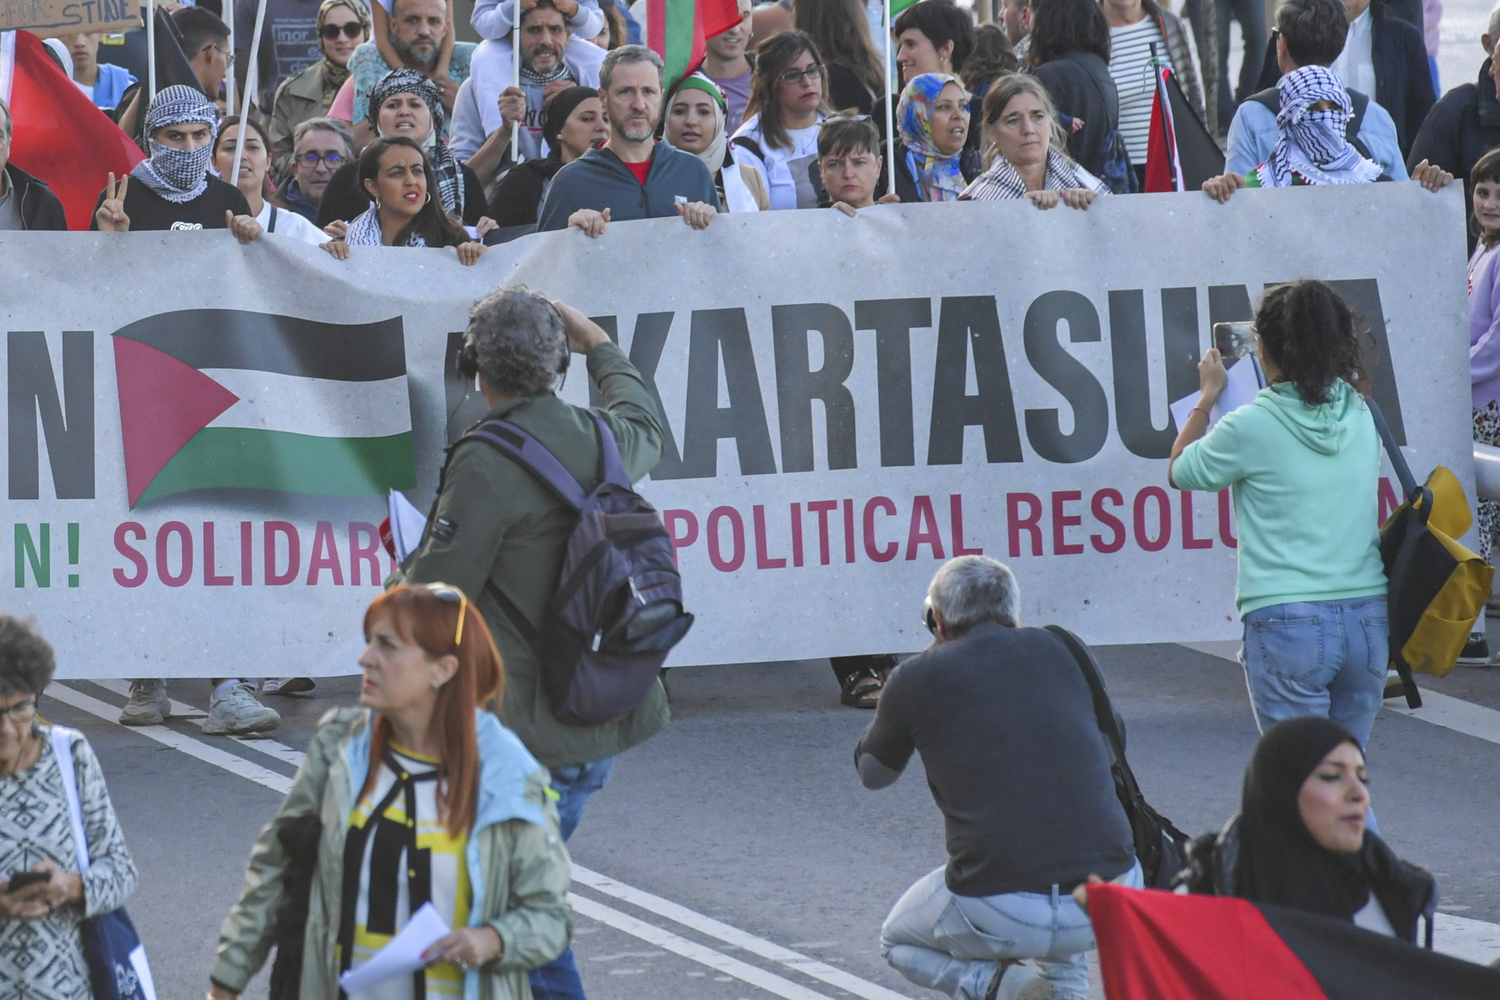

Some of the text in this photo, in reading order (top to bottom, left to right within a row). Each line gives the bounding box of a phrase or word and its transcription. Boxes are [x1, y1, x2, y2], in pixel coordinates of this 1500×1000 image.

[444, 278, 1408, 481] KARTASUA
[112, 519, 398, 588] SOLIDAR
[663, 493, 984, 573] POLITICAL
